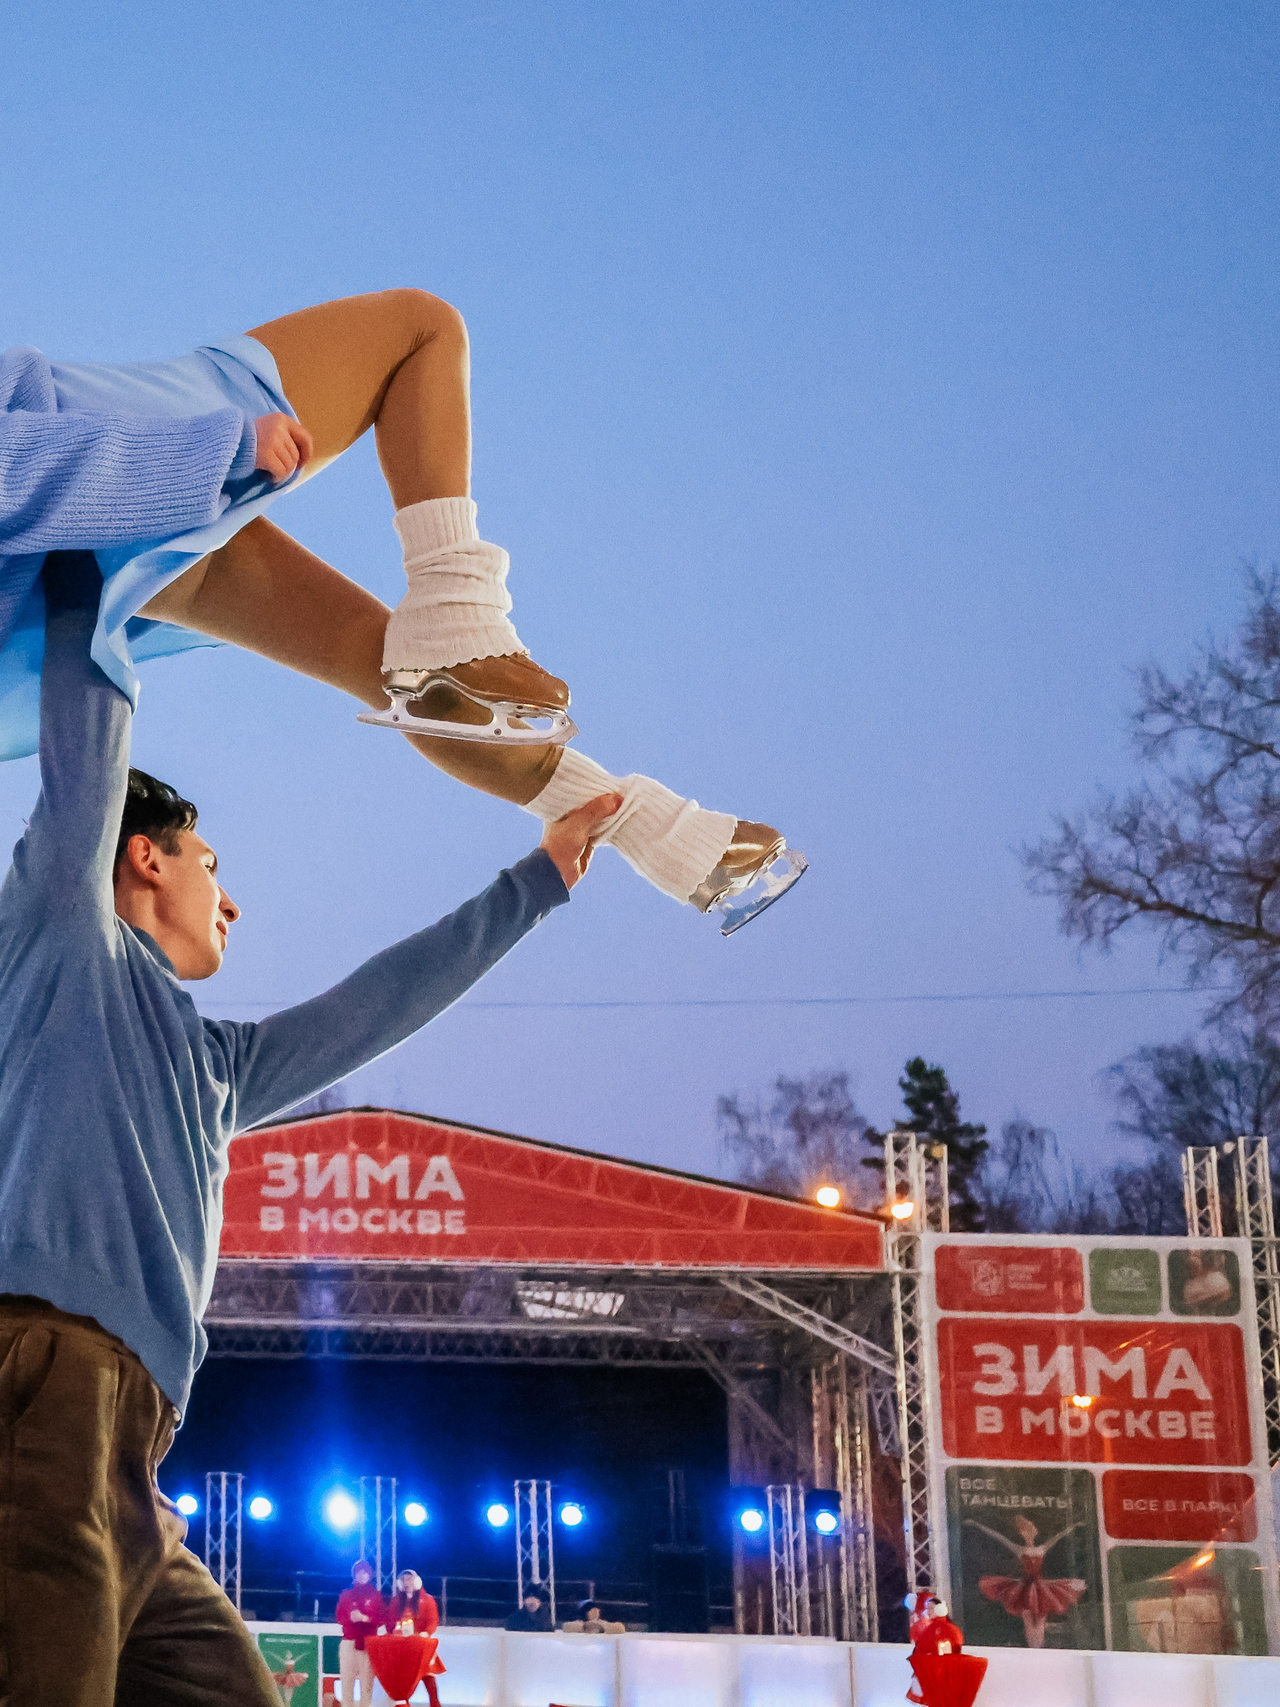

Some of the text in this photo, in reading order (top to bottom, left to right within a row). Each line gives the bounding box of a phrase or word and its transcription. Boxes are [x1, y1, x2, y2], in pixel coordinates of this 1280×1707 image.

[260, 1151, 465, 1201] ЗИМА
[260, 1206, 466, 1235] В МОСКВЕ
[973, 1342, 1213, 1400] ЗИМА
[975, 1405, 1216, 1440] В МОСКВЕ
[959, 1477, 996, 1491] ВСЕ
[1122, 1498, 1159, 1512] ВСЕ
[1163, 1500, 1177, 1513] В
